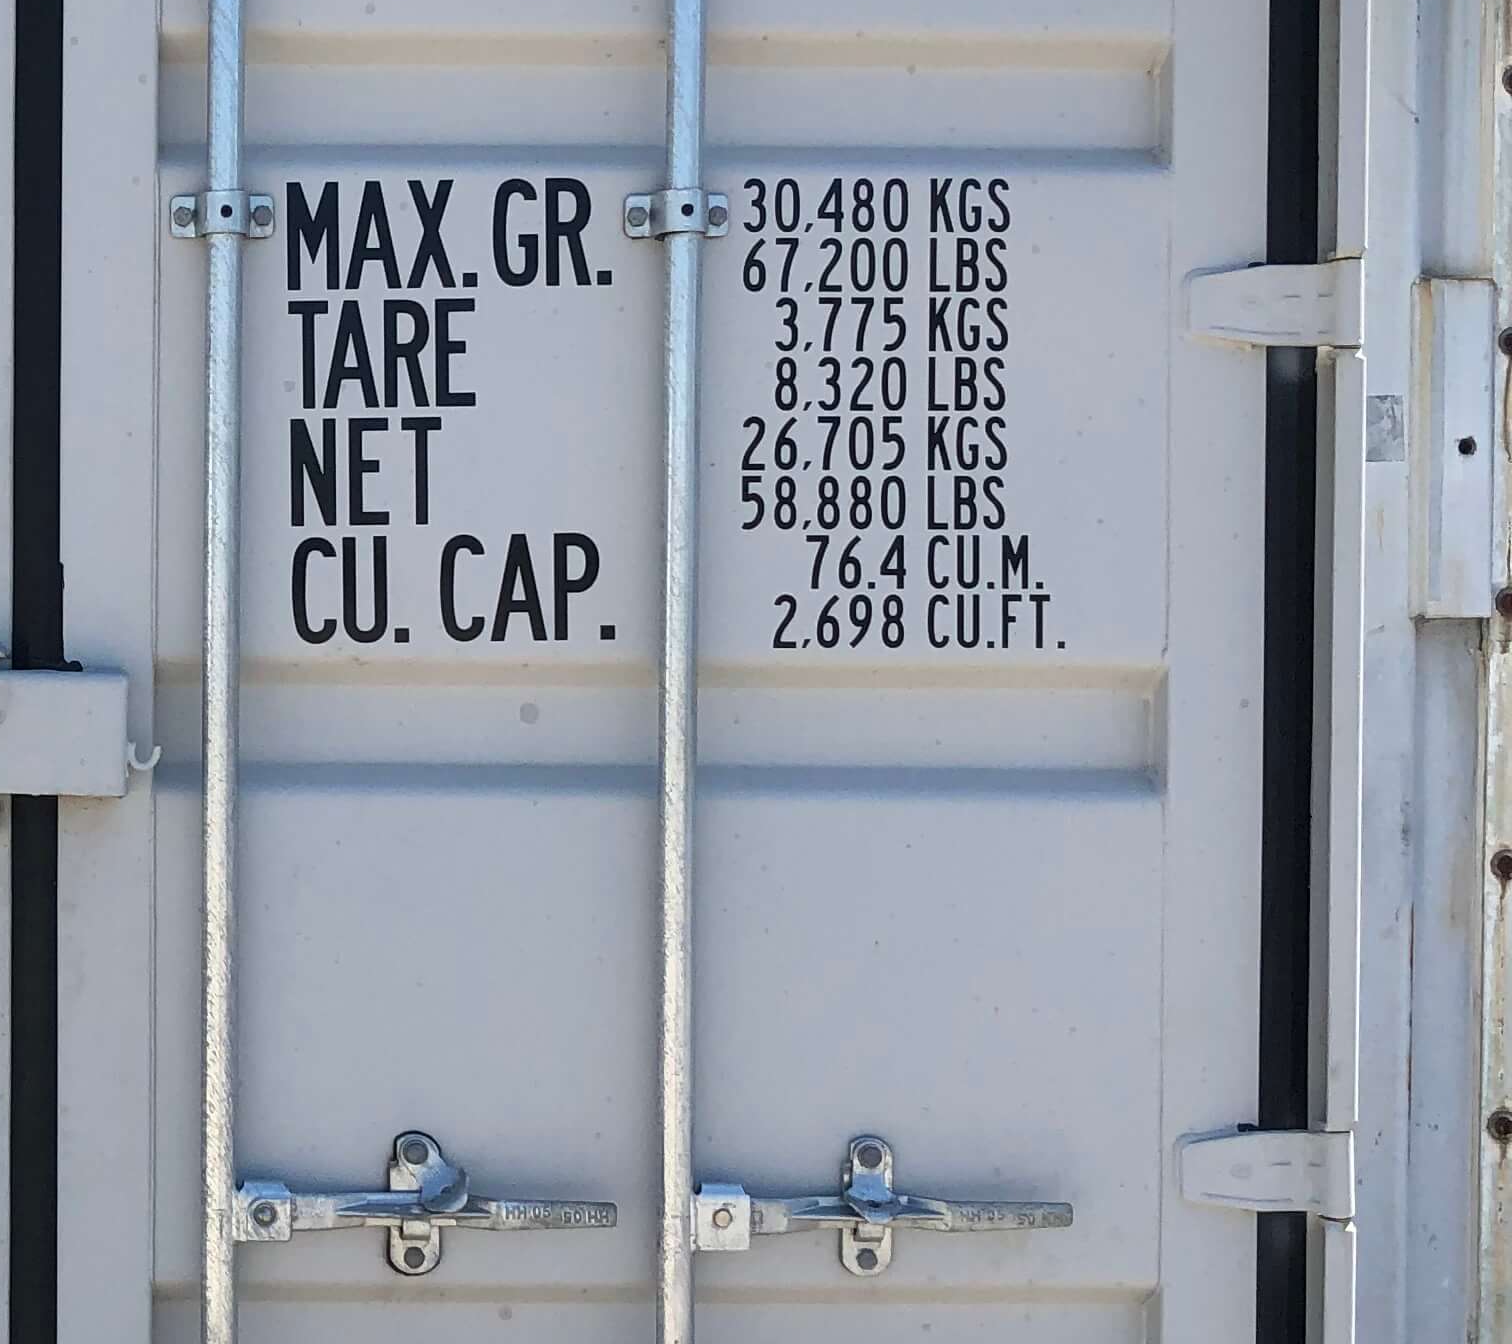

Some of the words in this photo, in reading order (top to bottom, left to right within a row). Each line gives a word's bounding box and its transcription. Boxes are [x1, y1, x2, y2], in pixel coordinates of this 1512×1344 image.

[741, 177, 909, 234] 30,480
[928, 177, 1011, 234] KGS
[741, 238, 909, 294] 67,200
[928, 238, 1008, 293] LBS
[774, 298, 908, 352] 3,775
[927, 297, 1009, 352] KGS
[289, 298, 476, 410] TARE
[774, 357, 908, 413] 8,320
[927, 357, 1007, 411] LBS
[291, 416, 441, 526] NET
[741, 416, 906, 472] 26,705
[927, 416, 1008, 471] KGS
[741, 476, 906, 531] 58,880
[927, 476, 1006, 529] LBS
[291, 535, 410, 645] CU.
[438, 533, 616, 641] CAP.
[805, 535, 908, 590] 76.4
[927, 535, 1045, 590] CU.M.
[772, 594, 906, 650] 2,698
[926, 594, 1066, 650] CU.FT.
